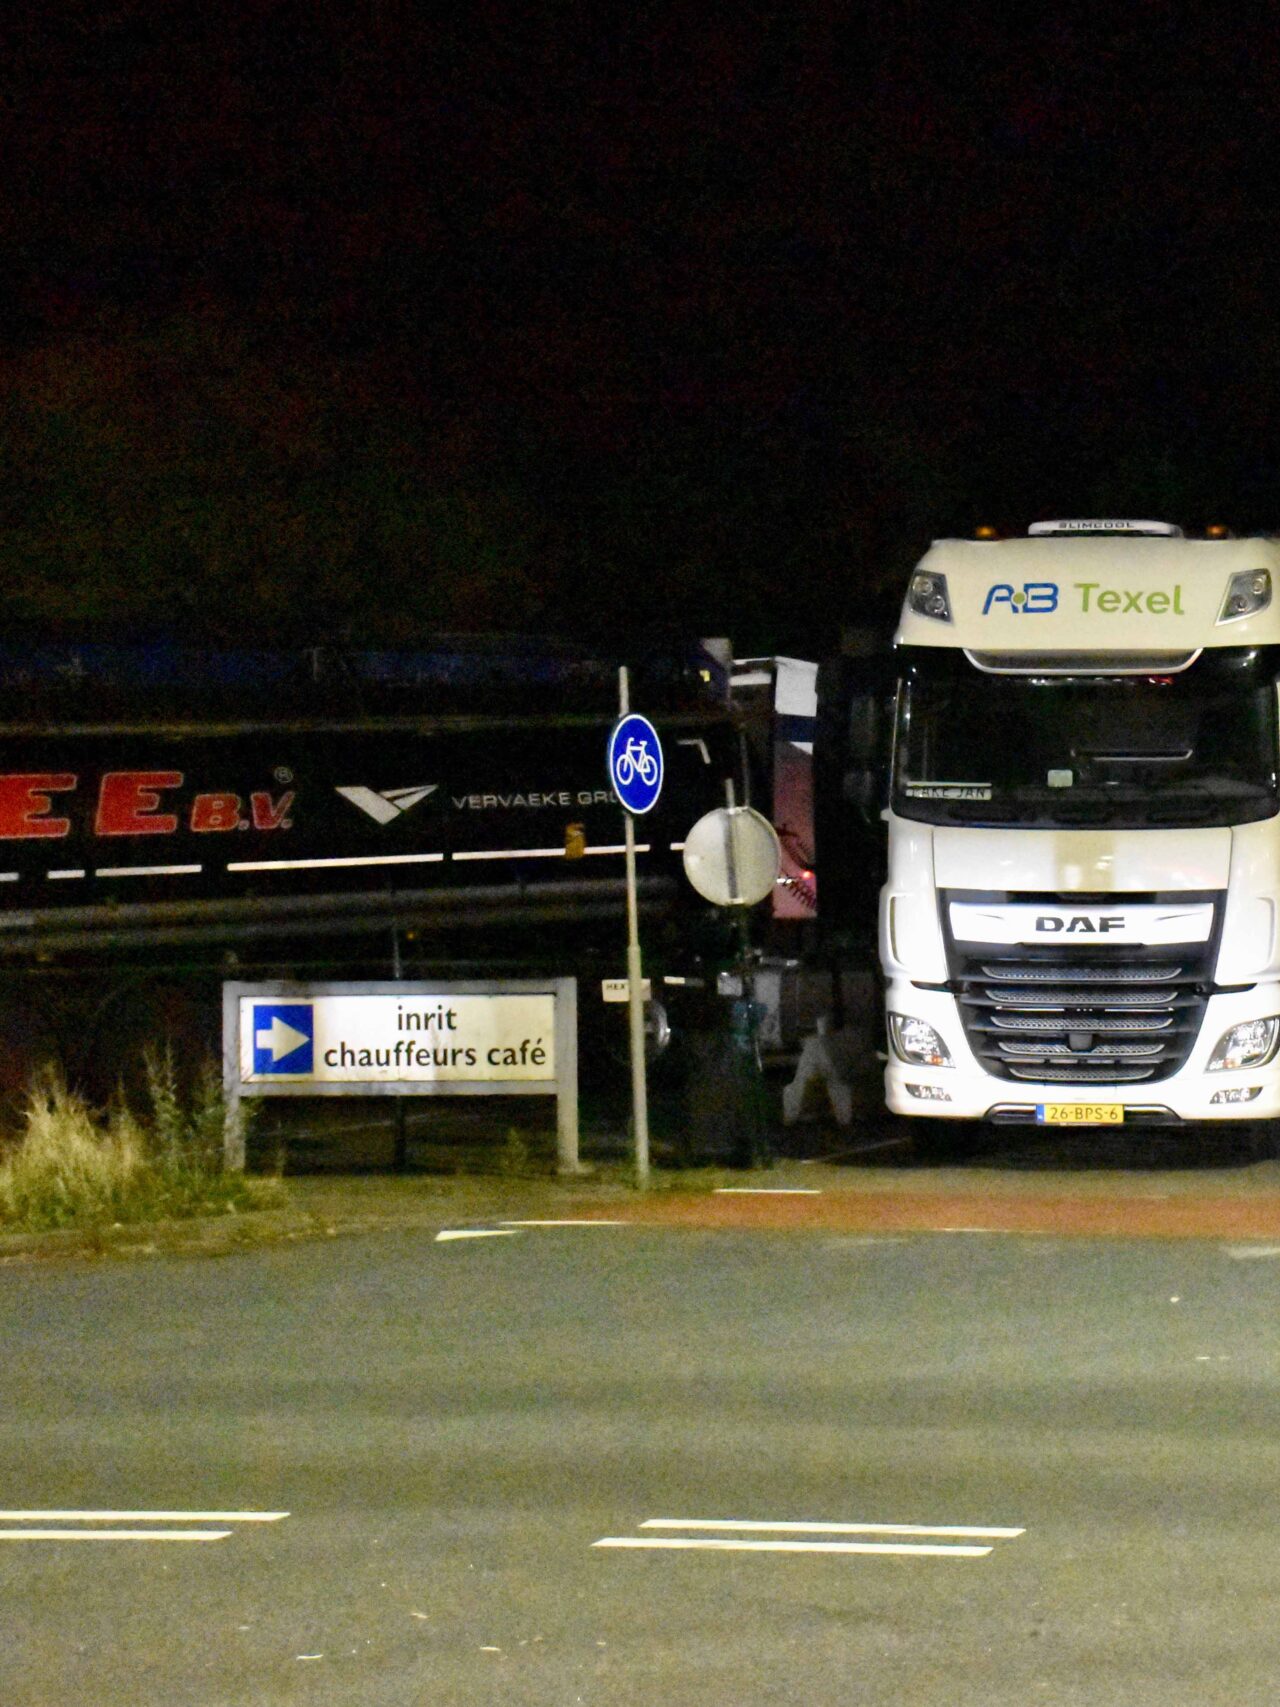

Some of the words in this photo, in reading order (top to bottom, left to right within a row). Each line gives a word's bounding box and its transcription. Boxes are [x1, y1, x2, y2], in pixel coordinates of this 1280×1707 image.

[1074, 583, 1184, 615] Texel
[190, 790, 295, 832] B.V.
[452, 792, 571, 809] VERVAEKE
[1036, 917, 1125, 932] DAF
[398, 1005, 457, 1031] inrit
[324, 1040, 477, 1067] chauffeurs
[487, 1038, 546, 1066] café
[1051, 1107, 1118, 1120] 26-BPS-6
